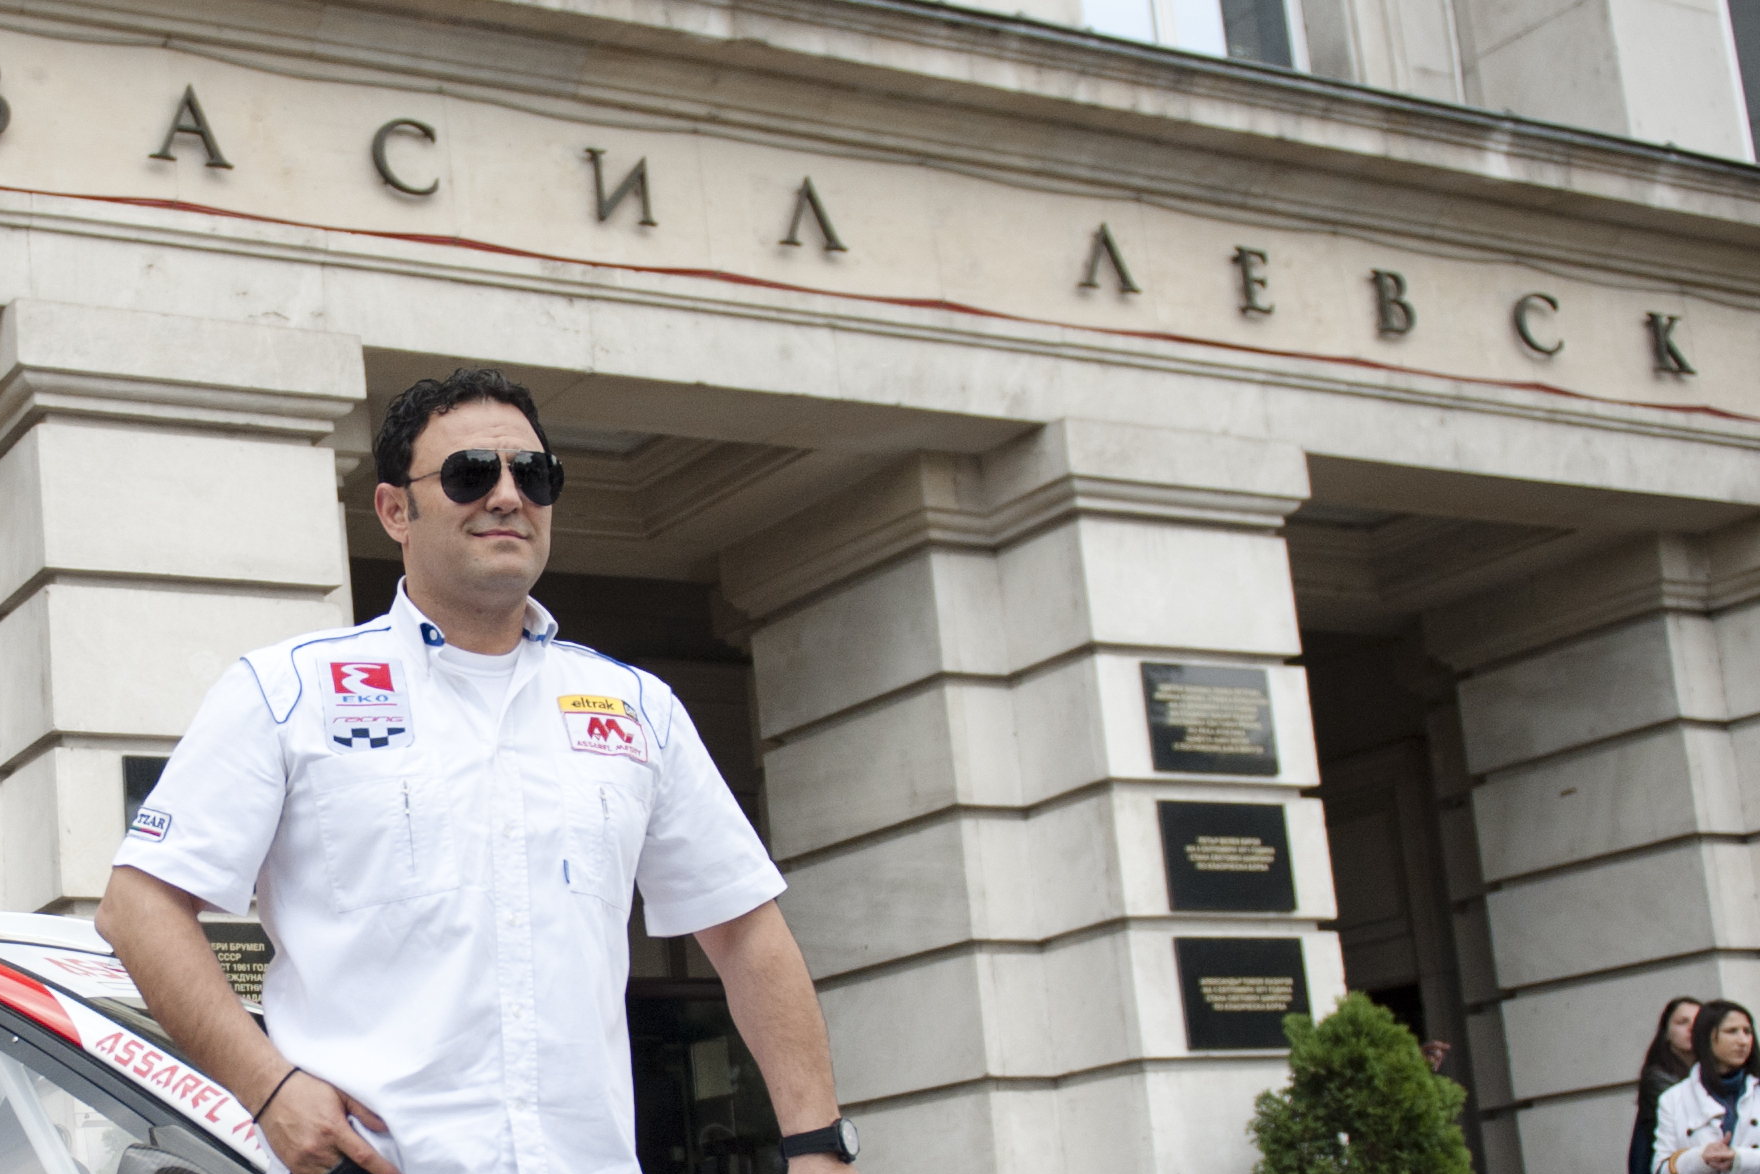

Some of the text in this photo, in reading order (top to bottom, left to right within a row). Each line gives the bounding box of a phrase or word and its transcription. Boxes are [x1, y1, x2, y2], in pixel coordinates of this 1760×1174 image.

[571, 698, 614, 710] eltrak
[211, 943, 265, 951] ЕРИ БРУМЕЛ
[226, 974, 263, 983] ЕЖДУНА
[95, 1031, 231, 1124] ASSAREL
